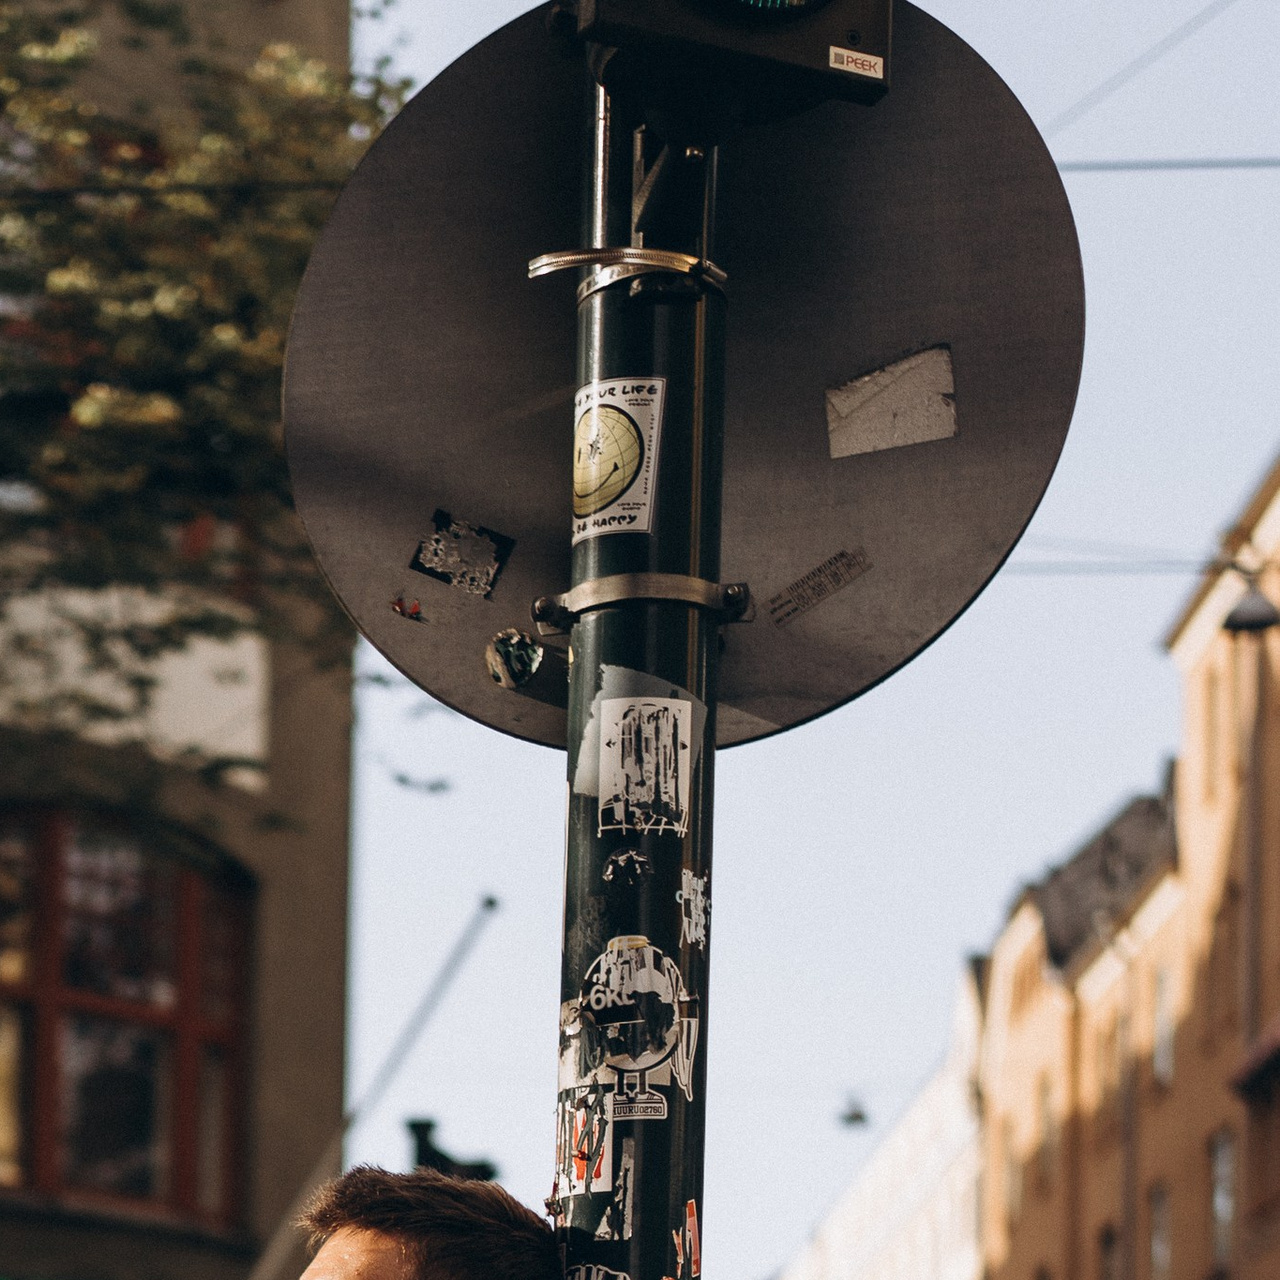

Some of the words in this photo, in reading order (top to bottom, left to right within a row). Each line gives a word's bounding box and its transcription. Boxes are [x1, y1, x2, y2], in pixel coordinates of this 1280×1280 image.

[846, 55, 878, 73] PEEK
[622, 384, 658, 396] LIFE
[593, 514, 637, 528] HAPPY
